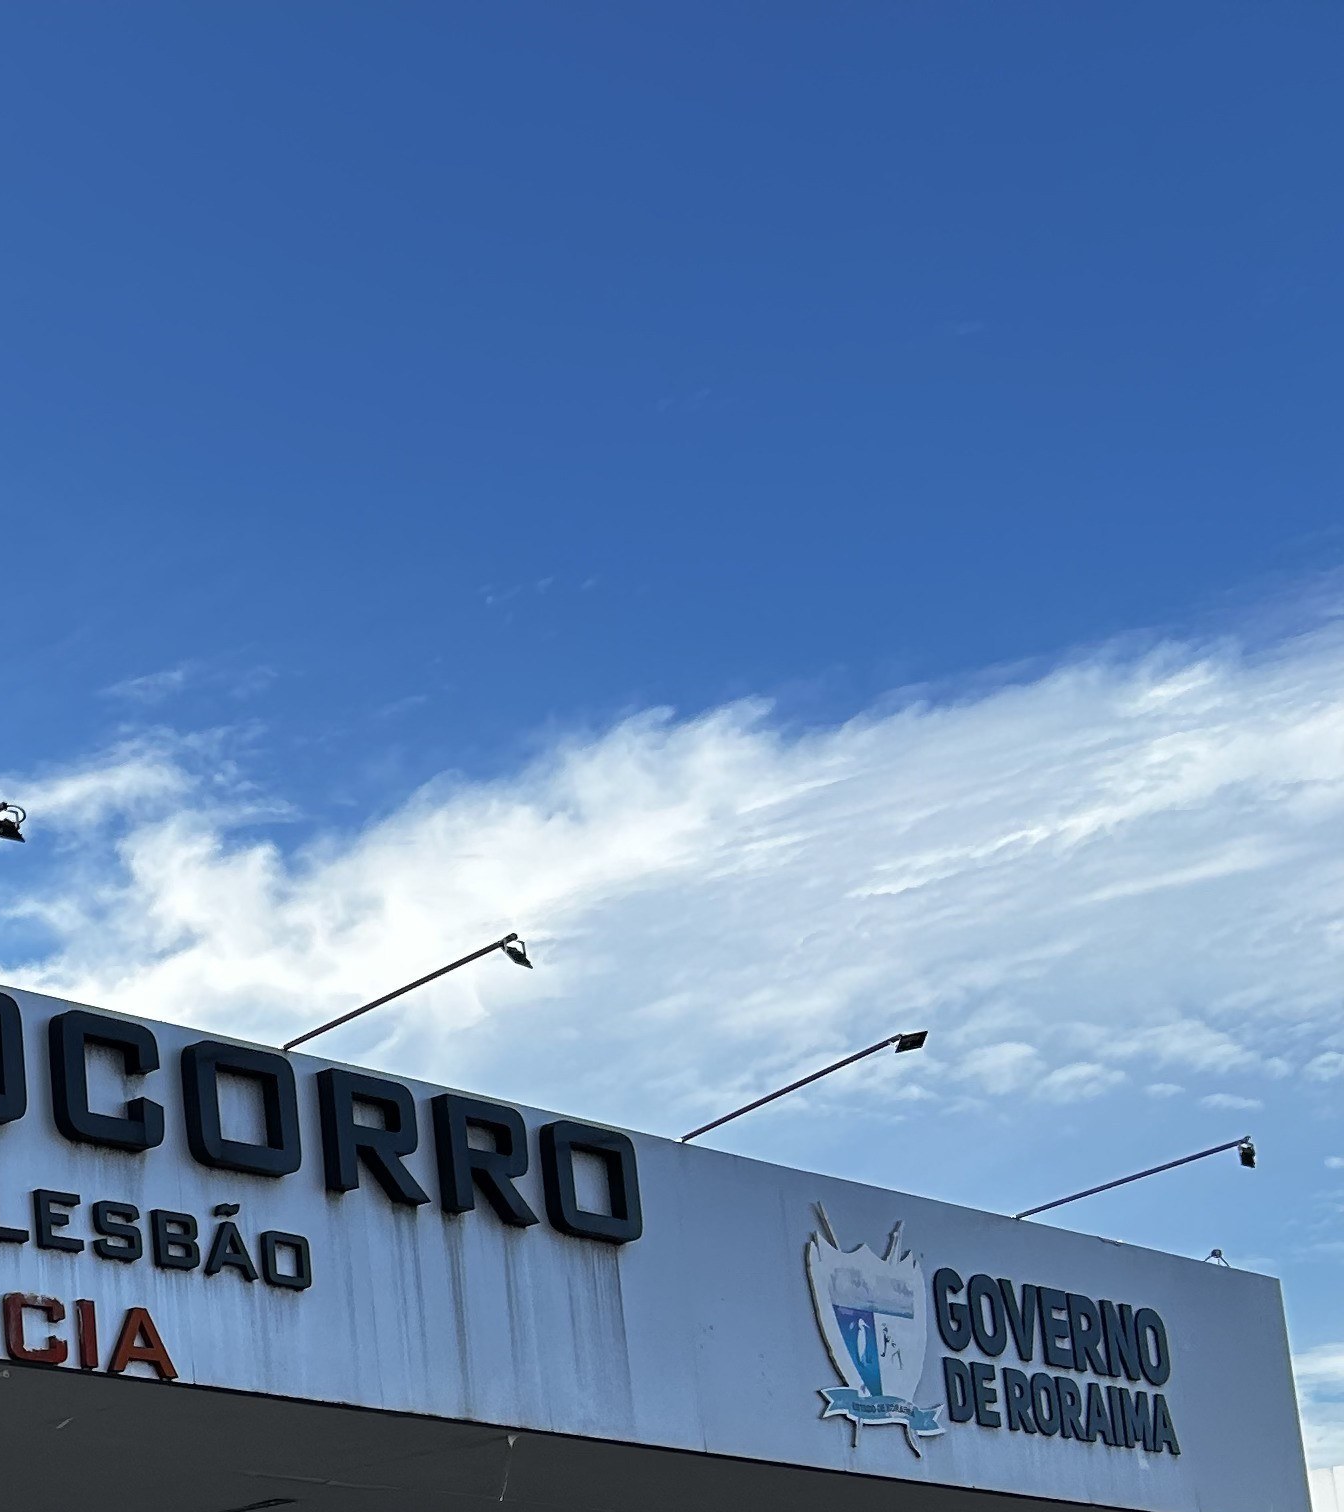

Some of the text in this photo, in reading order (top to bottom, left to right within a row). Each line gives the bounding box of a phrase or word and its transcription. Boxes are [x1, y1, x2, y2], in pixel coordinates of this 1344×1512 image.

[932, 1267, 1171, 1386] GOVERNO
[943, 1356, 1181, 1456] DE RORAIMA
